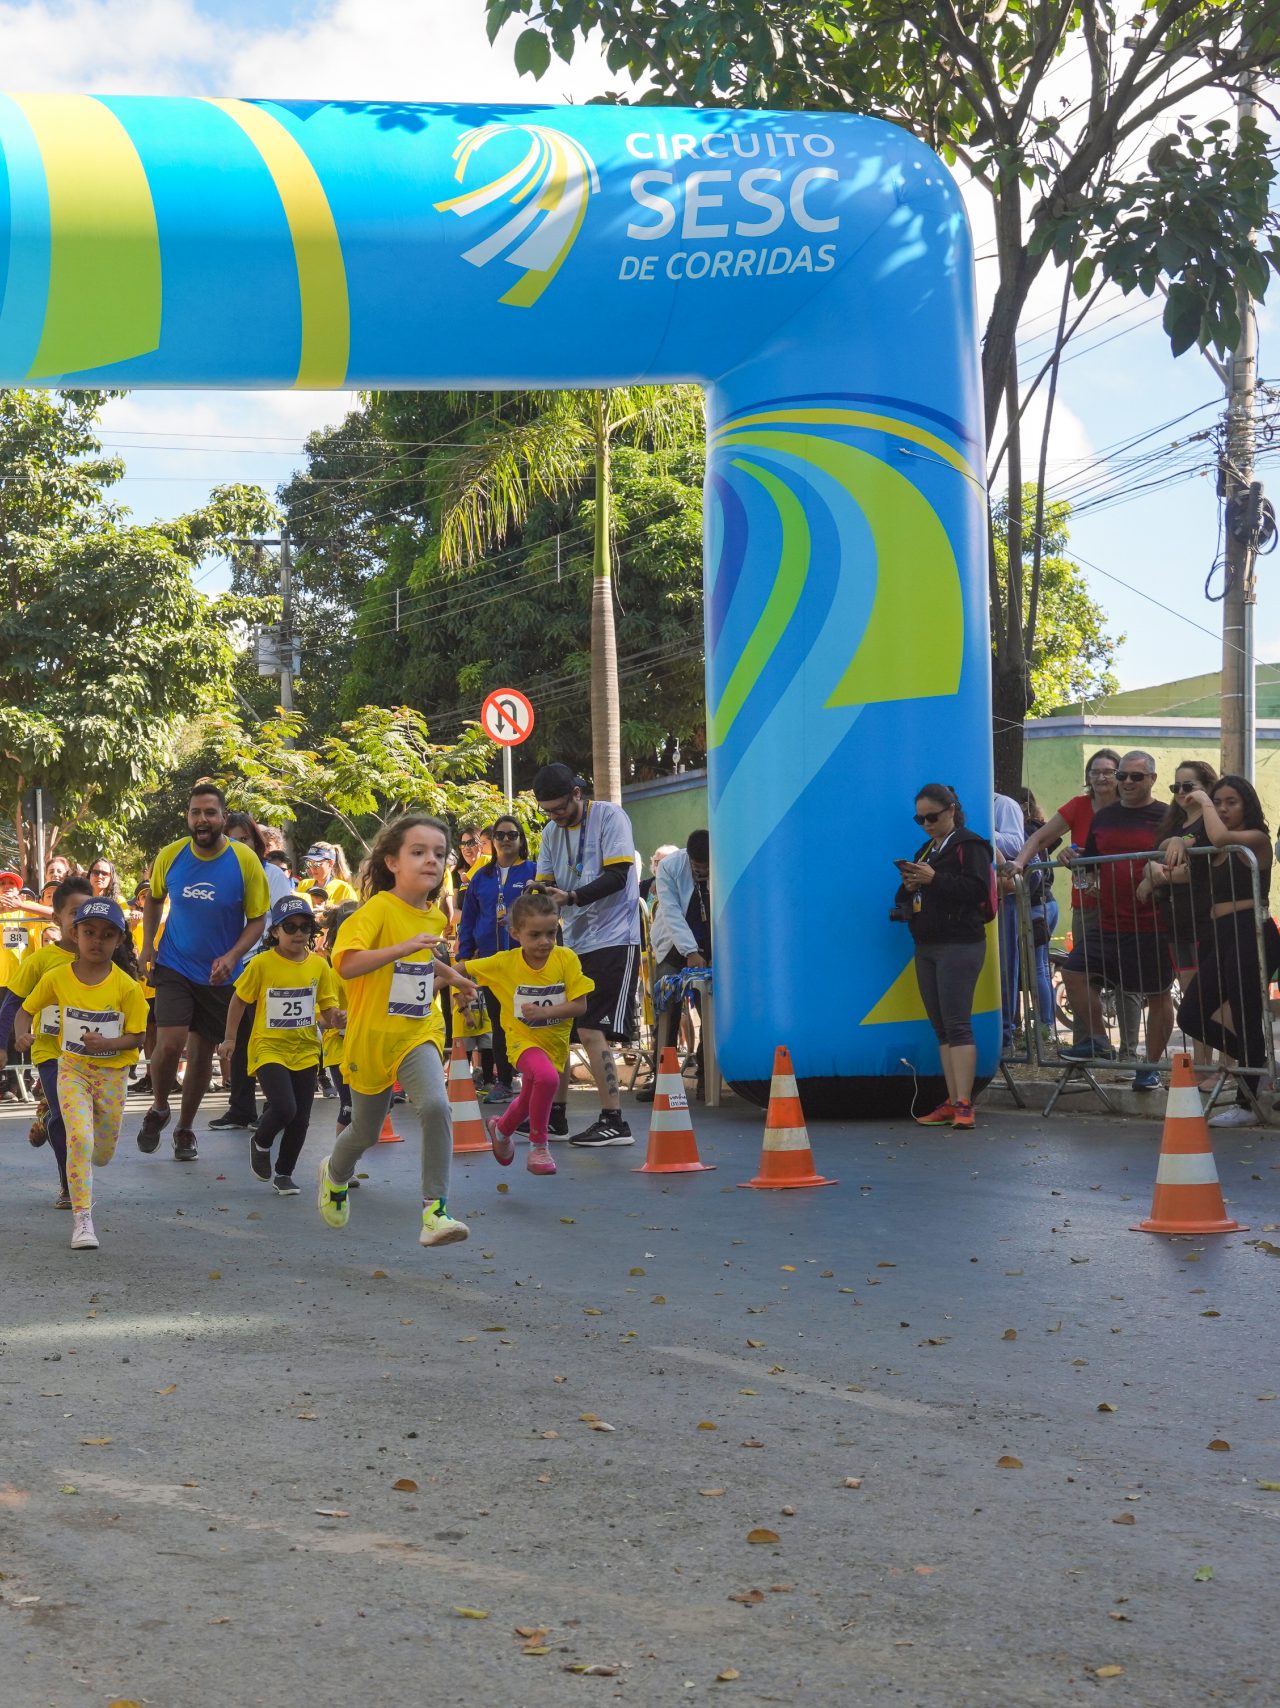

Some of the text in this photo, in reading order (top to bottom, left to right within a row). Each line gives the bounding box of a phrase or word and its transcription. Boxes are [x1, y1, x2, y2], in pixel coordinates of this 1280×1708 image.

[625, 132, 836, 160] CIRCUITO
[626, 167, 840, 241] SESC
[618, 244, 837, 281] DE CORRIDAS
[182, 886, 216, 901] Sesc
[415, 981, 426, 1002] 3
[282, 1001, 303, 1017] 25
